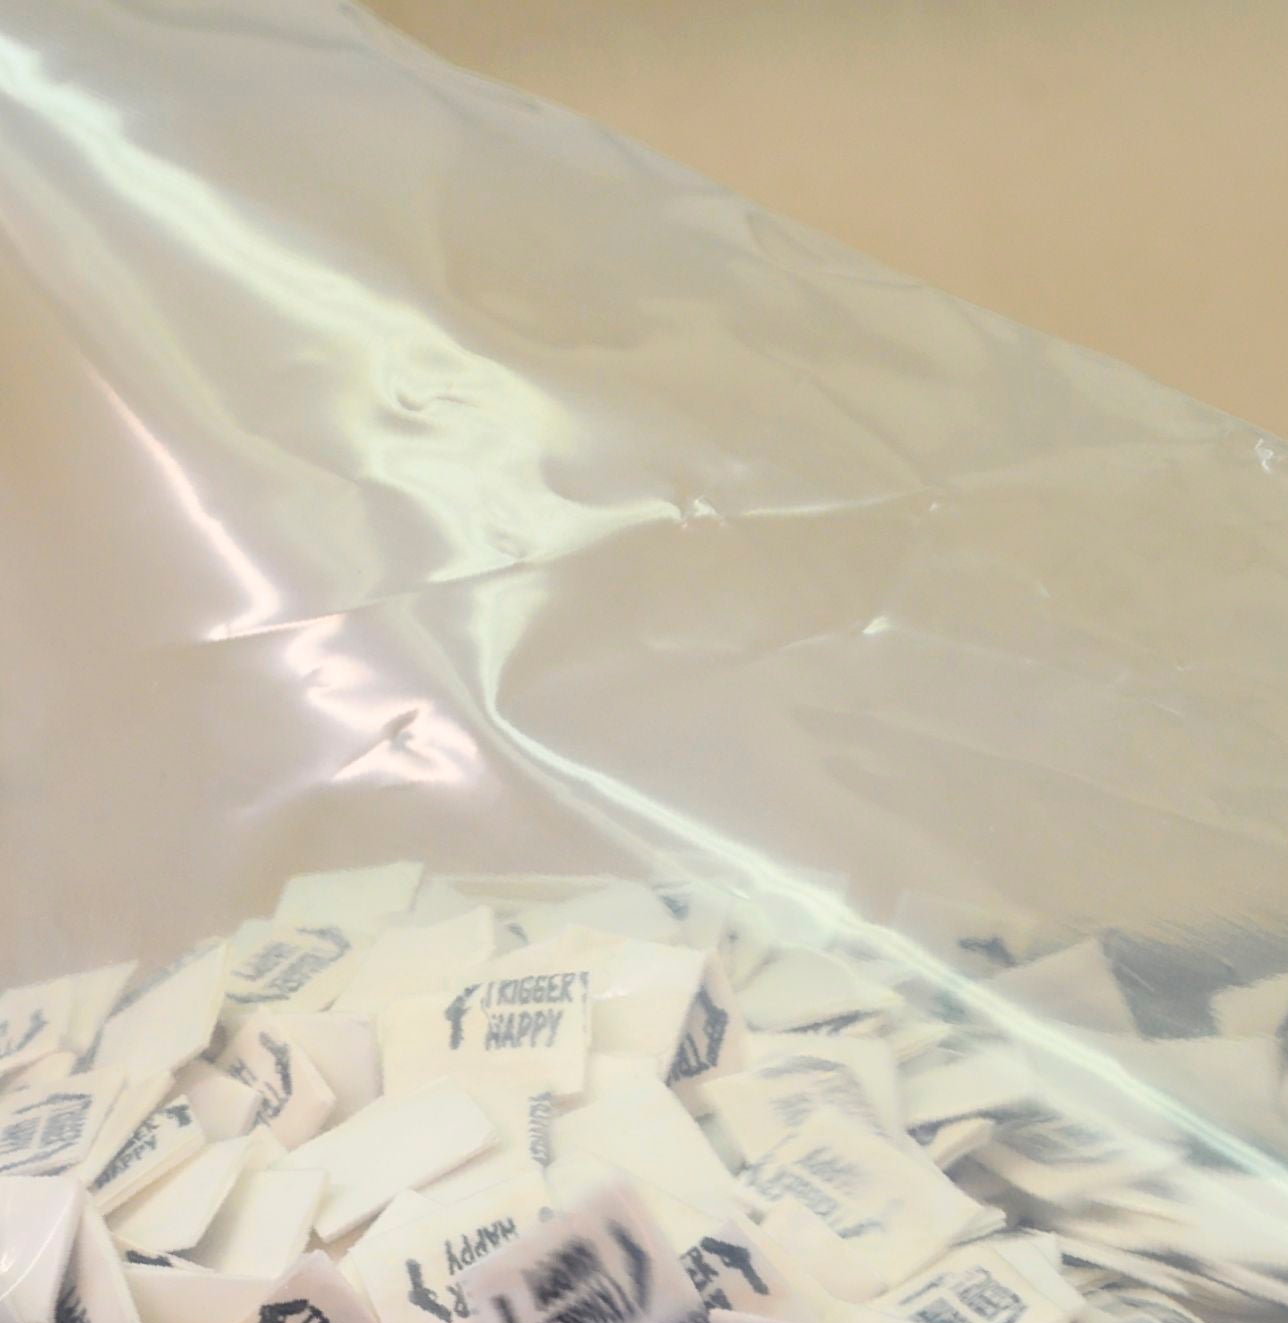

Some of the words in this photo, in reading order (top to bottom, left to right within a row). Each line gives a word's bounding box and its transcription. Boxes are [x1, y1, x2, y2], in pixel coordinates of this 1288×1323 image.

[481, 972, 576, 1008] TRIGGER
[484, 1008, 563, 1050] HAPPY
[445, 1216, 517, 1275] HAPPY
